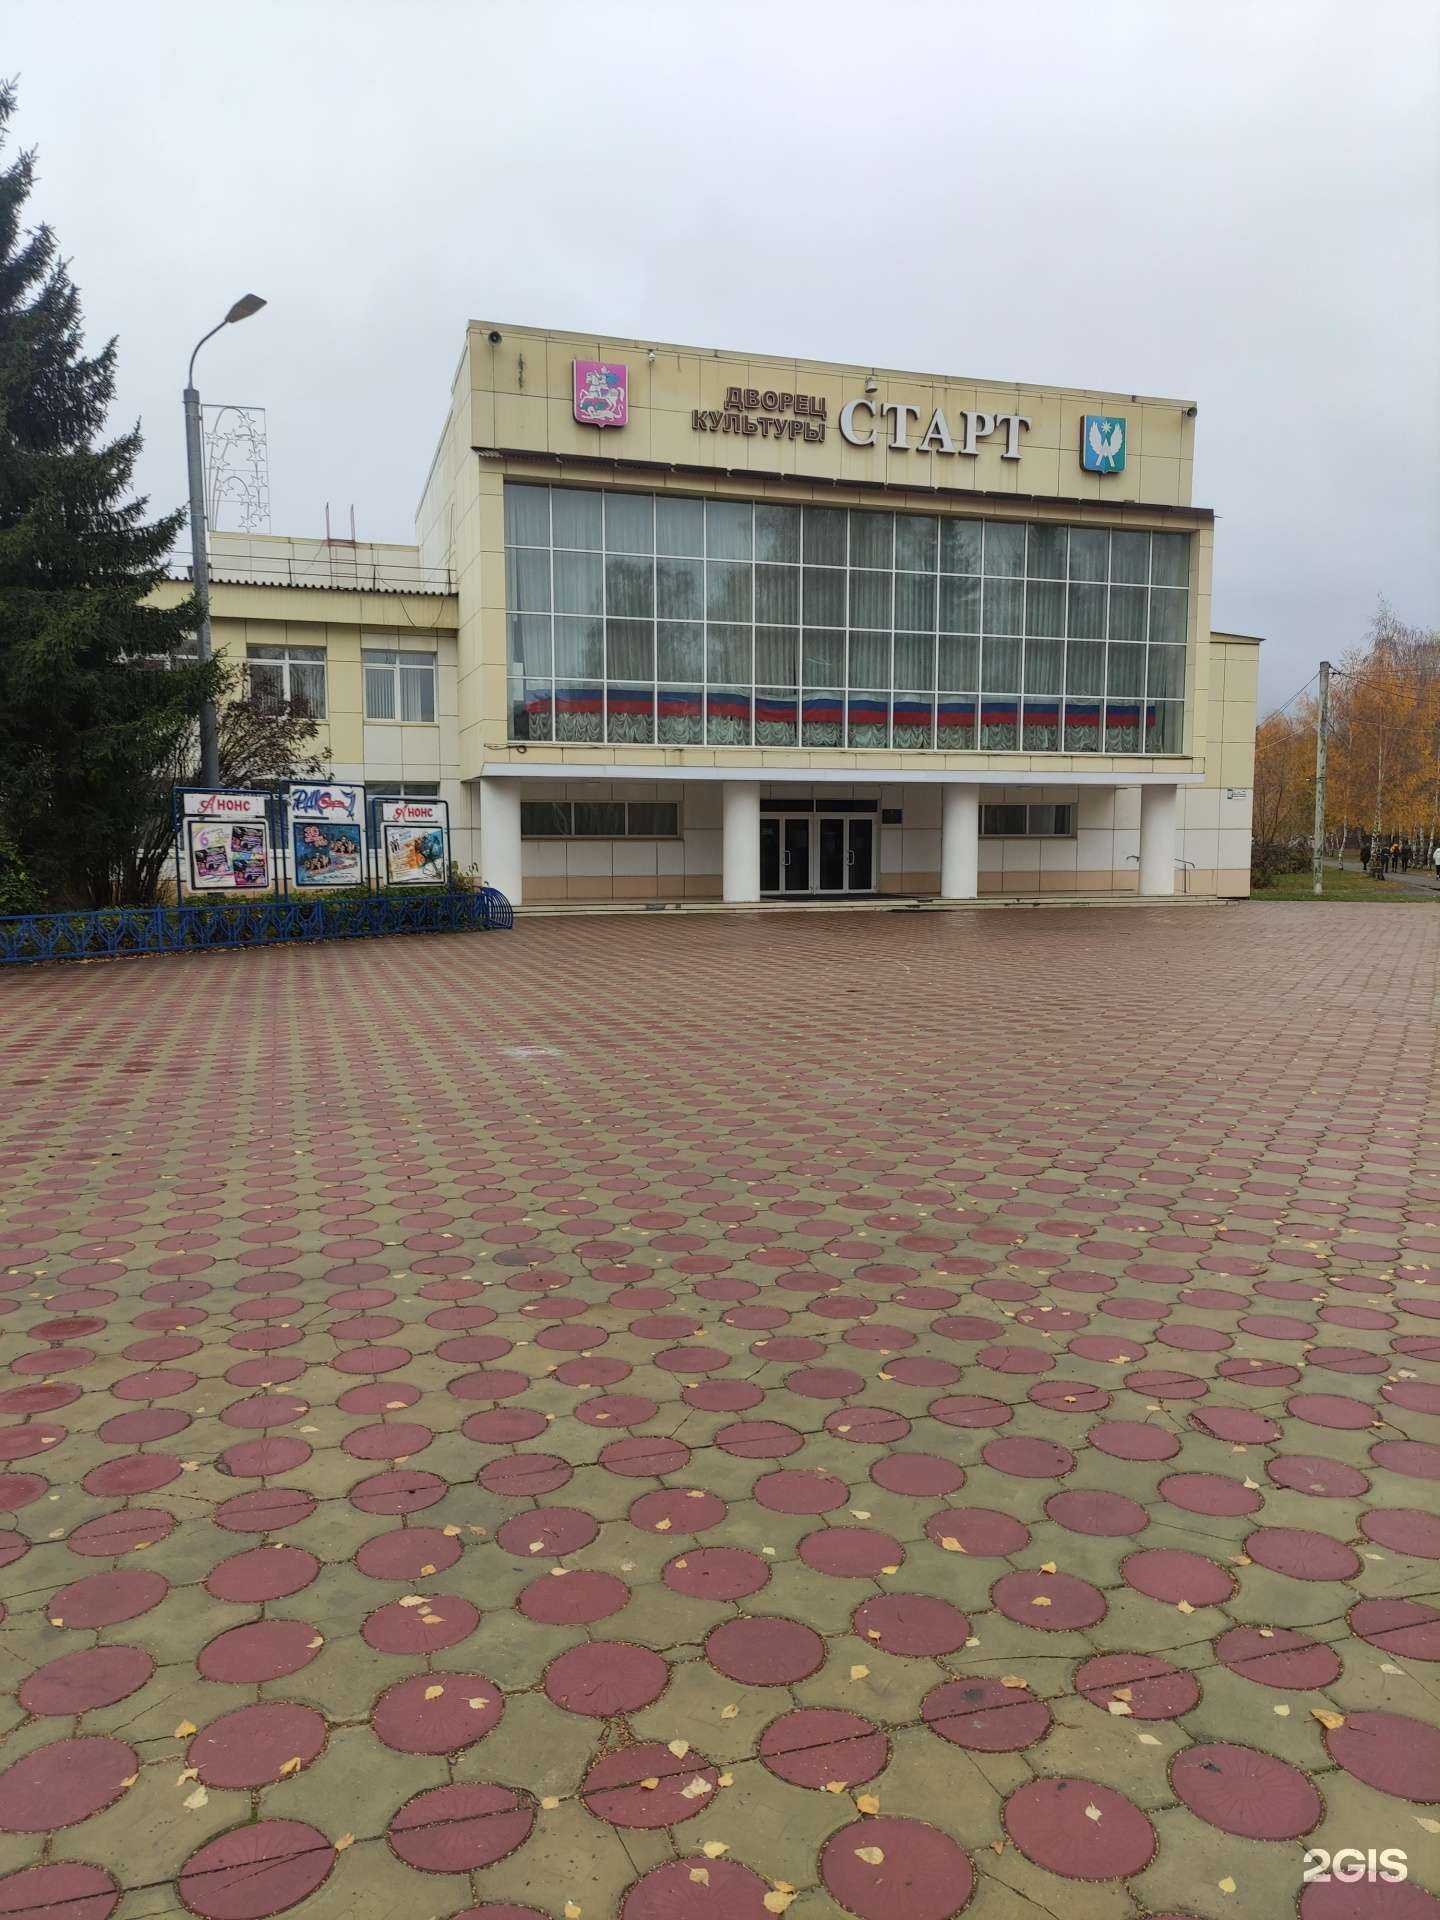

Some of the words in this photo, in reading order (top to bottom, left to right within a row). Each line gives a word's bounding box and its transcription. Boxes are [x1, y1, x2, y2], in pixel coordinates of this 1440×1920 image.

[723, 386, 828, 420] ДВОРЕЦ
[691, 408, 827, 442] КУЛЬТУРЫ
[838, 399, 1033, 460] СТАРТ
[197, 795, 251, 814] АНОНС
